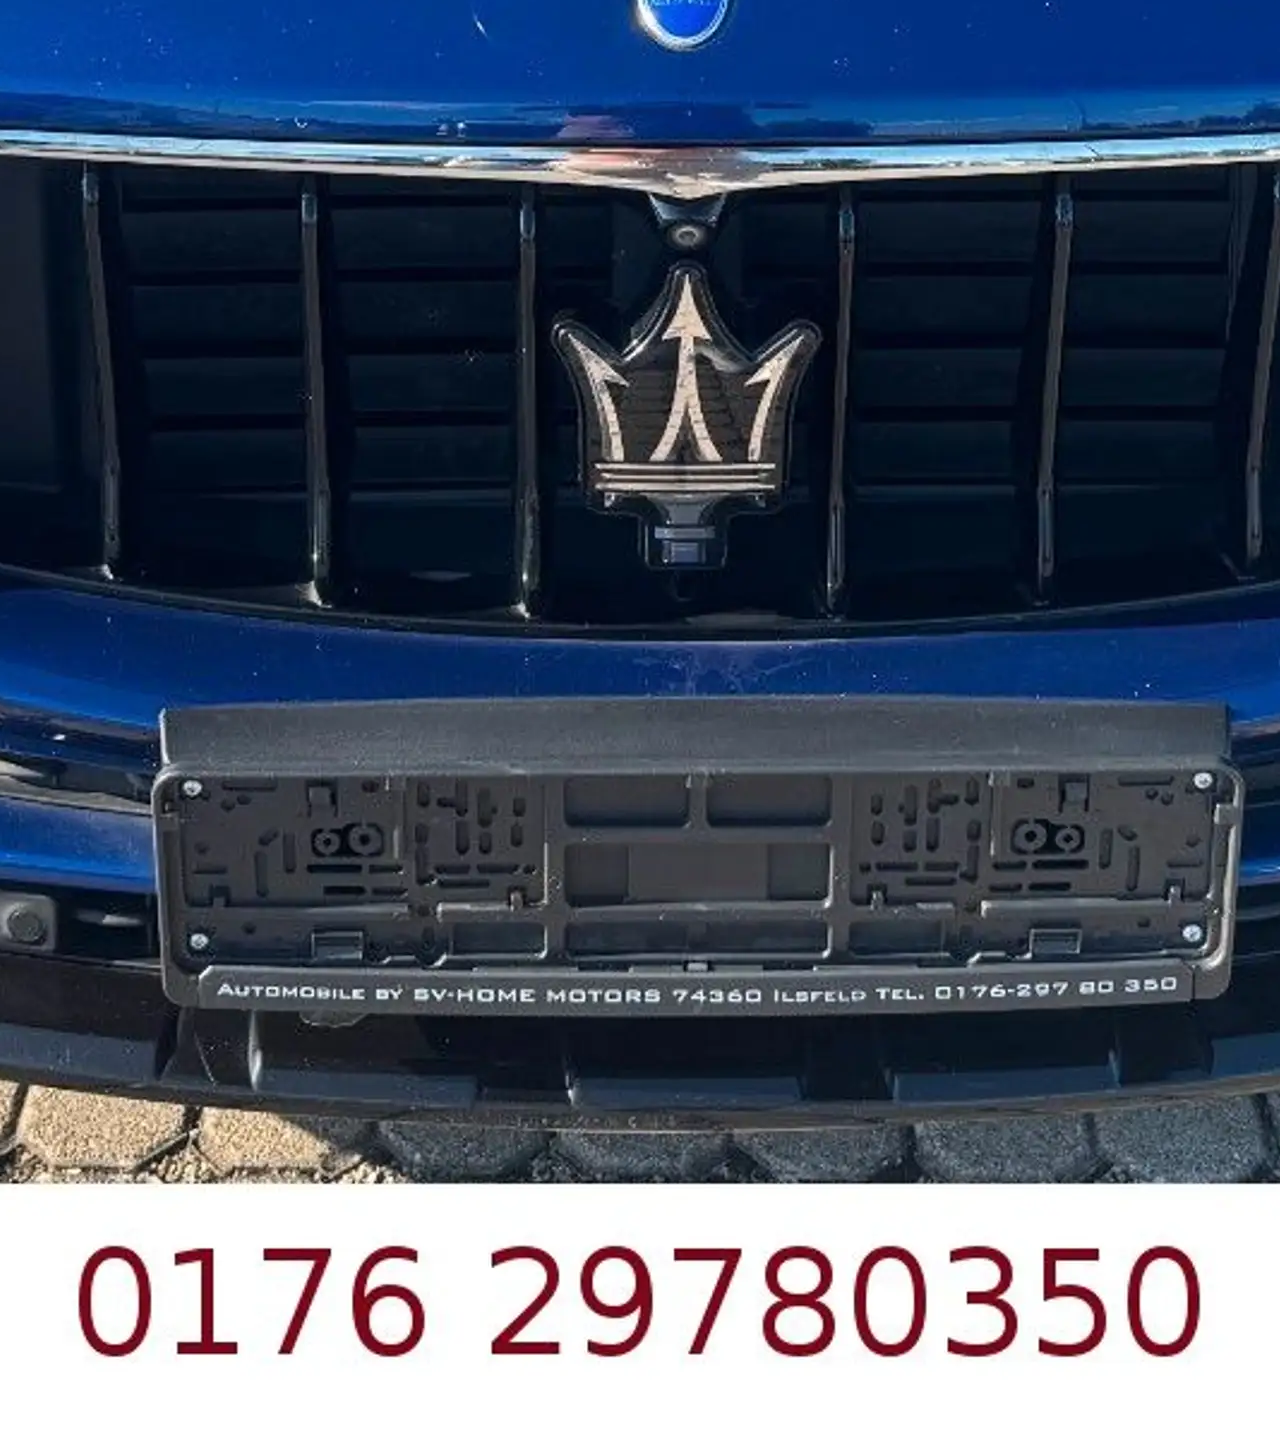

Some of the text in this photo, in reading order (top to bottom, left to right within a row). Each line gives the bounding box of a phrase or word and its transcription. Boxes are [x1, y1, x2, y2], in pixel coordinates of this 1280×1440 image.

[413, 988, 536, 1002] SV-HOME
[546, 988, 661, 1003] MOTORS
[672, 988, 762, 1003] 74360
[934, 981, 1069, 1000] 0176-297
[1079, 980, 1114, 994] 80
[1124, 976, 1177, 992] 350
